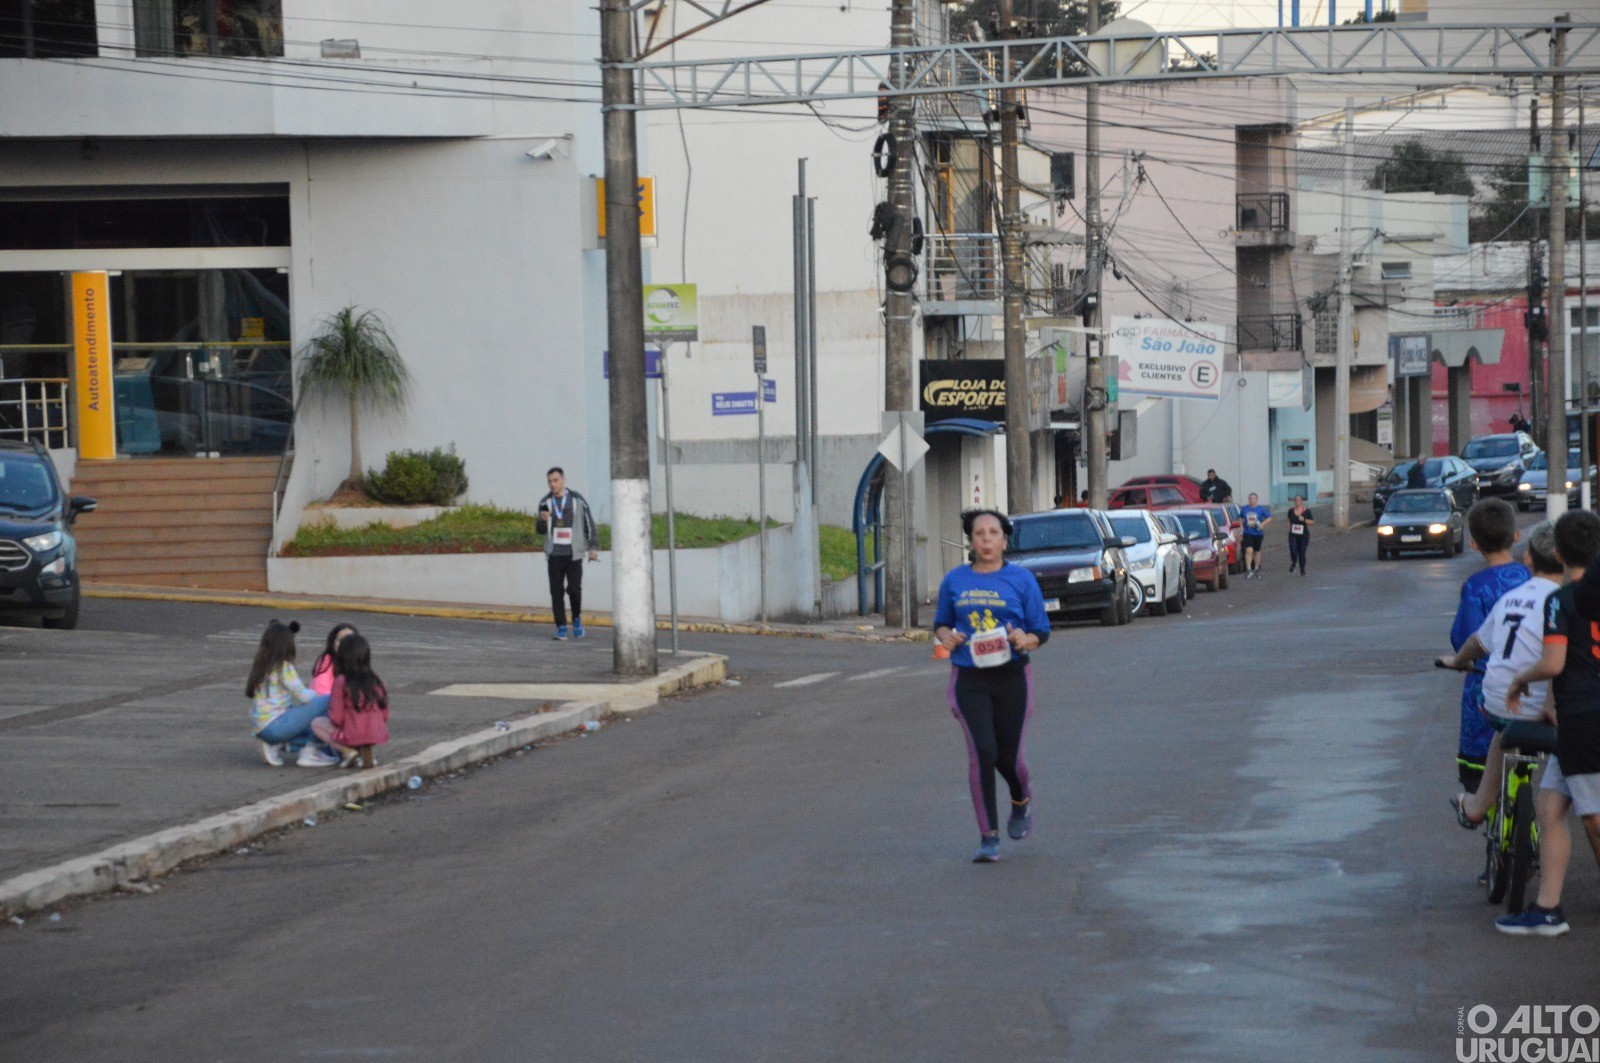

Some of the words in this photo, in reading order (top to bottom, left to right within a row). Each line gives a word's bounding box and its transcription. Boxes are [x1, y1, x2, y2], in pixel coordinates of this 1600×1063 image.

[85, 287, 100, 411] Autoatendimento
[1141, 336, 1173, 352] São
[1176, 338, 1217, 355] João
[1139, 362, 1187, 372] EXCLUSIVO
[1197, 366, 1210, 383] E
[1141, 371, 1183, 381] CLIENTES
[952, 379, 987, 390] LOJA
[937, 391, 1007, 406] ESPORTE
[1503, 613, 1525, 659] 7
[978, 639, 1004, 653] 052
